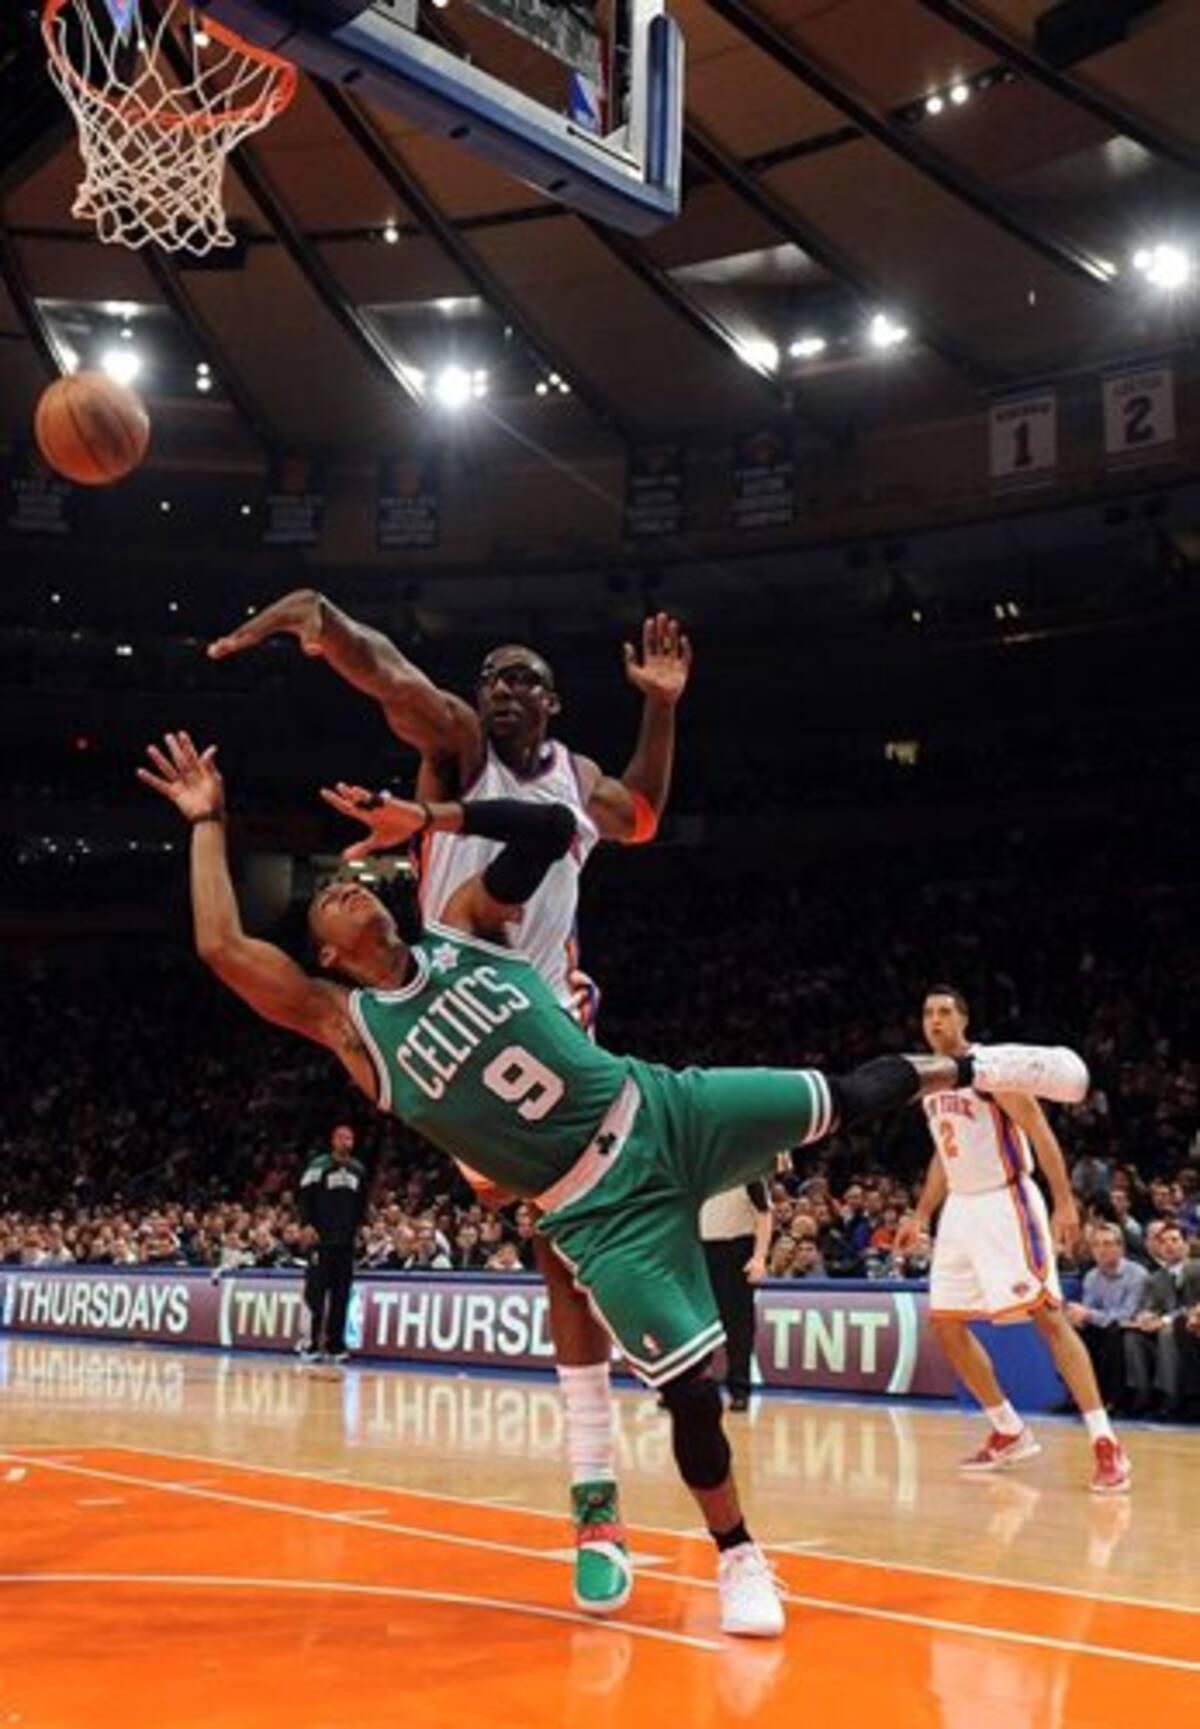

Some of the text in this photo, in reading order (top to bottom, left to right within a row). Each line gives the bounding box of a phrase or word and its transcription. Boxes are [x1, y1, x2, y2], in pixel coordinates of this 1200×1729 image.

[1013, 421, 1032, 467] 1
[1124, 395, 1153, 444] 2
[396, 966, 531, 1099] CELTICS
[483, 1045, 565, 1121] 9
[19, 1280, 189, 1333] THURSDAYS
[763, 1308, 890, 1374] TNT
